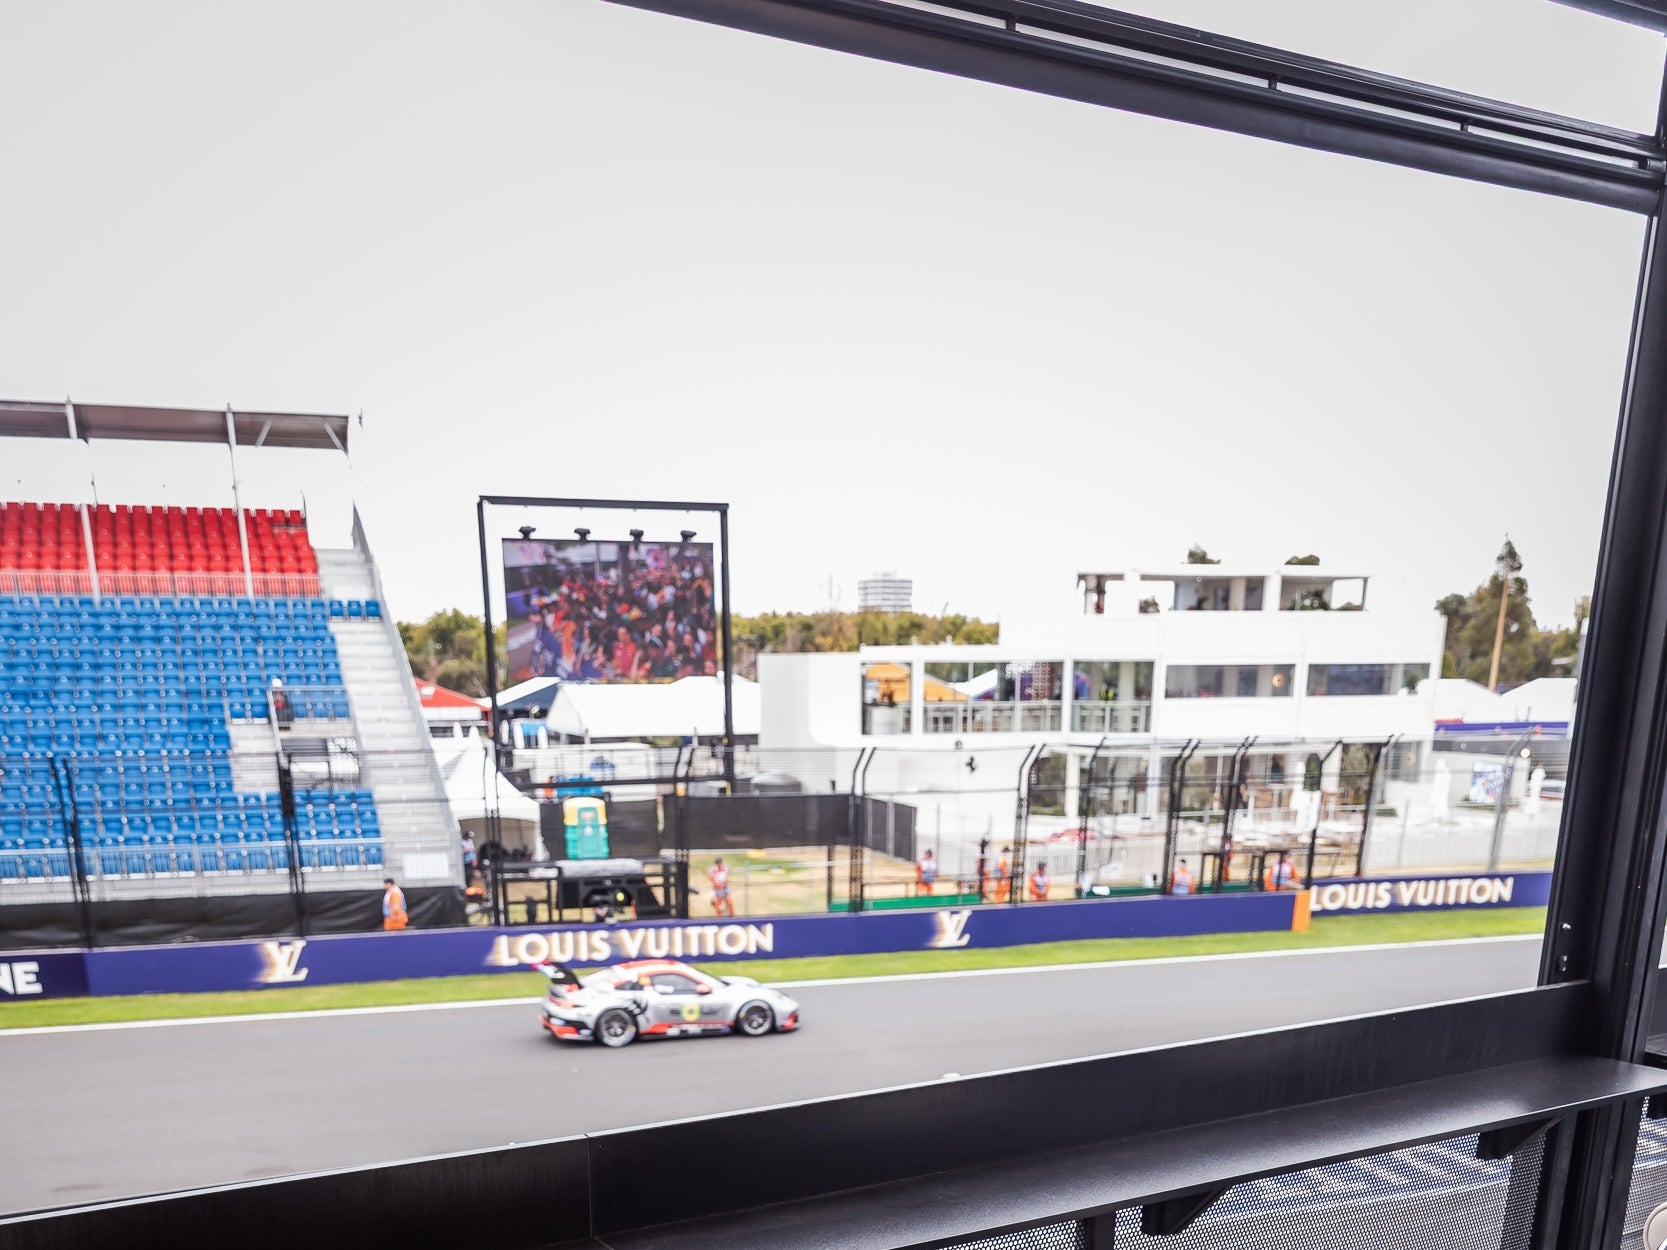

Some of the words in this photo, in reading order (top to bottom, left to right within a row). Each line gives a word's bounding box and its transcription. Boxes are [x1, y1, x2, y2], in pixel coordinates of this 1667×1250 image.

[1309, 882, 1392, 911] LOUIS
[1399, 876, 1514, 907] VUITTON
[497, 929, 611, 967] LOUIS
[619, 923, 774, 959] VUITTON
